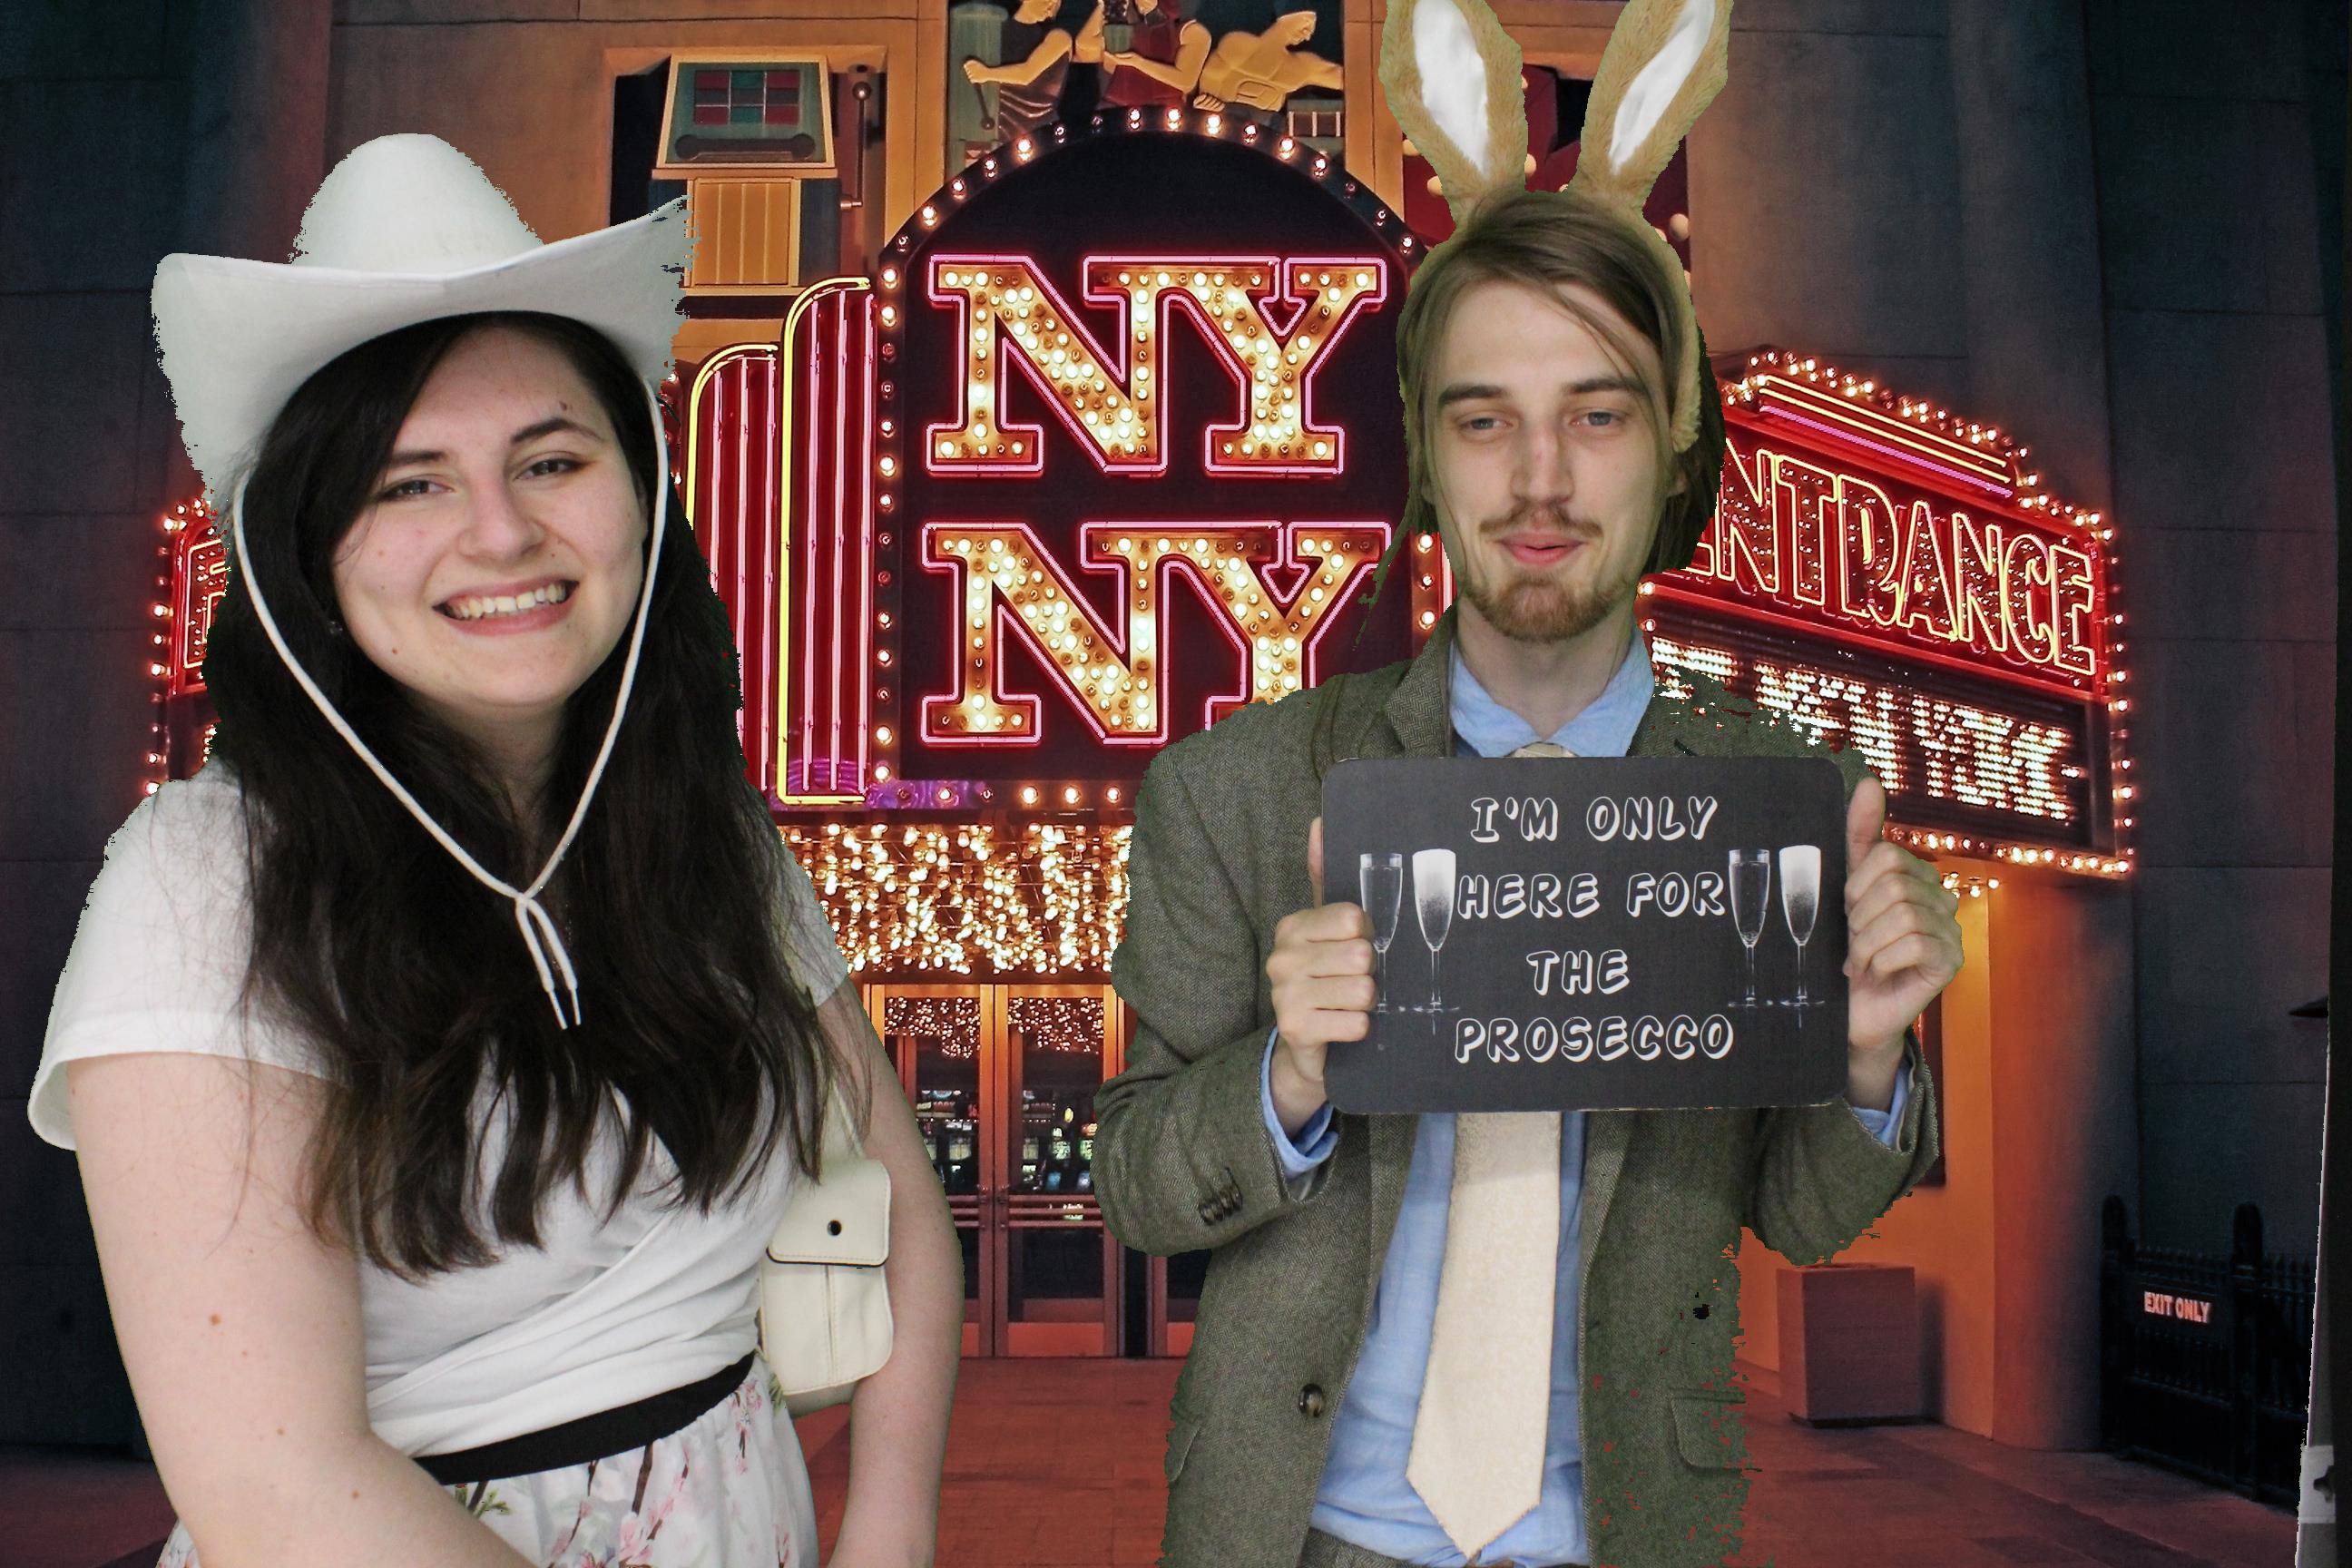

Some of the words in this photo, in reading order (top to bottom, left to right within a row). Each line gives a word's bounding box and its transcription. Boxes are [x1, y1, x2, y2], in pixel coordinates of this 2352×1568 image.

[926, 254, 1387, 475] NY
[1685, 437, 2096, 676] NTRANCE
[922, 522, 1391, 746] NY
[1471, 797, 1559, 843] I'M
[1586, 796, 1718, 842] ONLY
[1457, 873, 1601, 919] HERE
[1626, 872, 1726, 917] FOR
[1526, 949, 1630, 995] THE
[1455, 1014, 1734, 1063] PROSECCO
[2143, 1290, 2173, 1316] EXIT
[2175, 1297, 2210, 1324] ONLY
